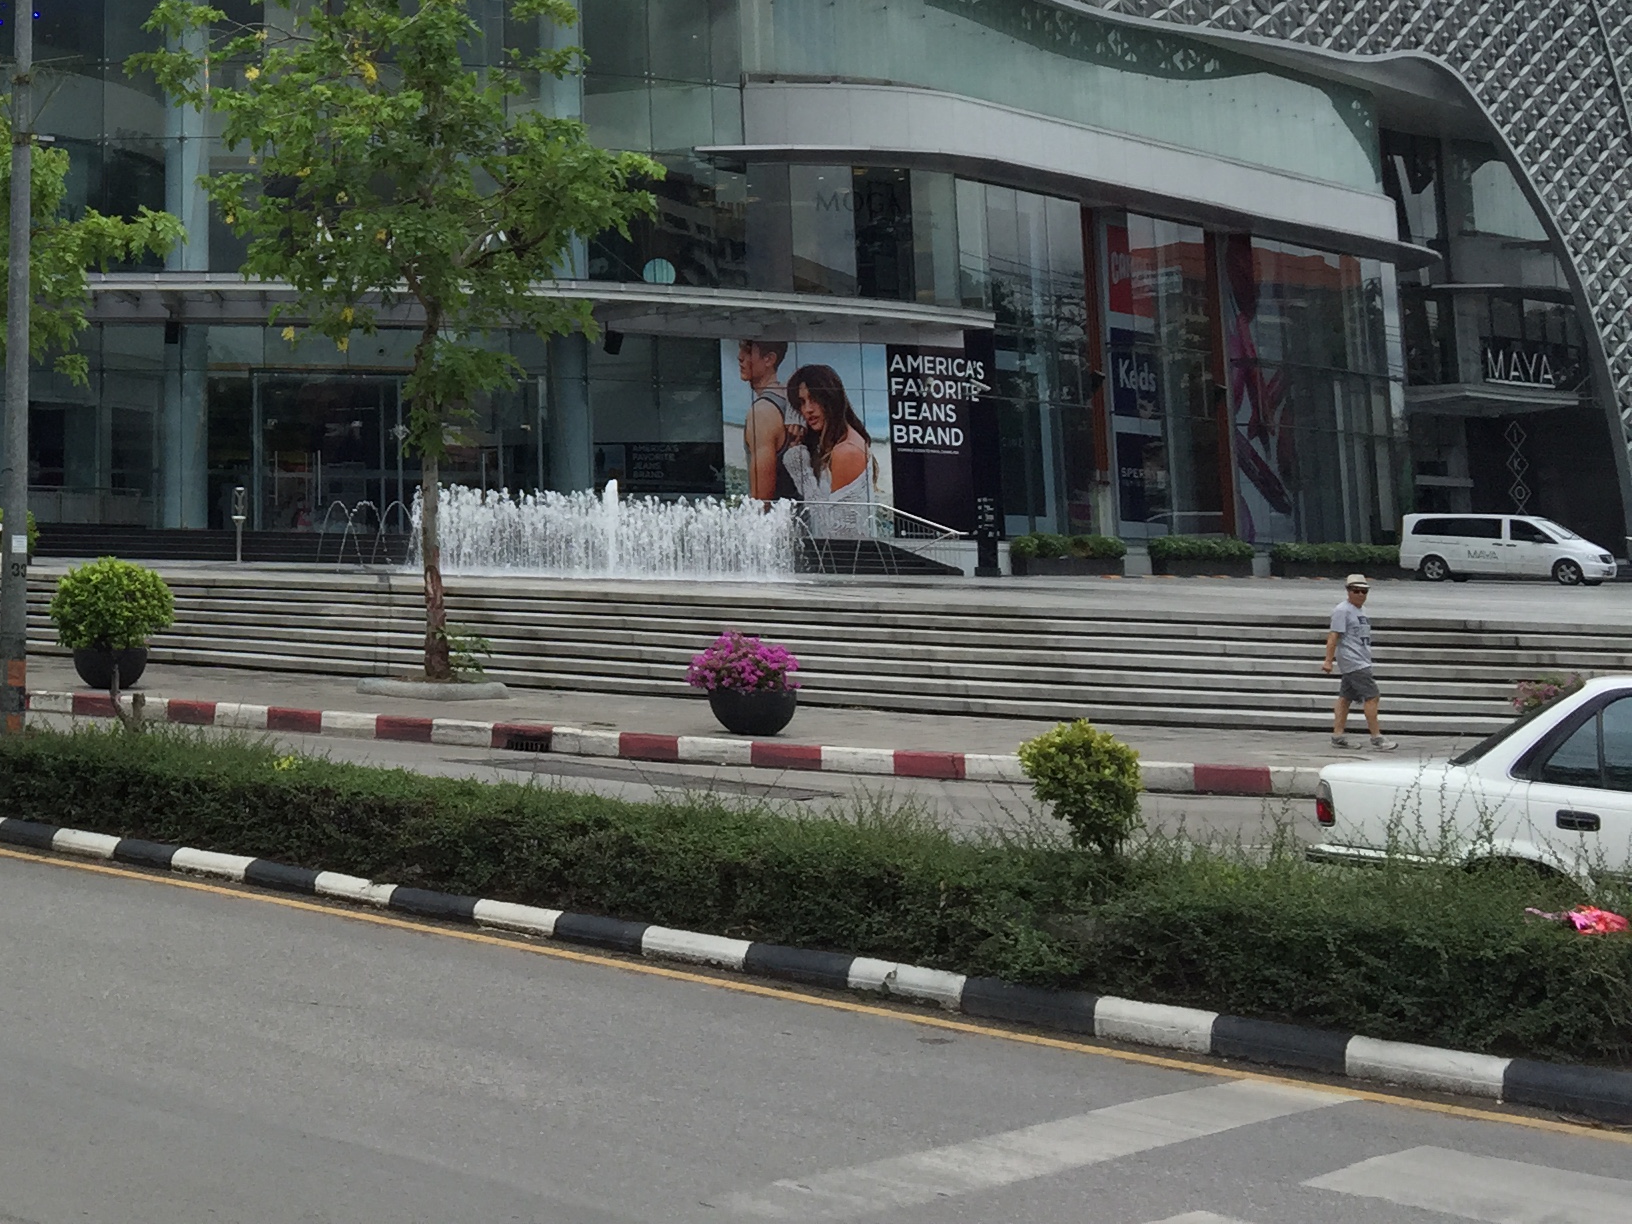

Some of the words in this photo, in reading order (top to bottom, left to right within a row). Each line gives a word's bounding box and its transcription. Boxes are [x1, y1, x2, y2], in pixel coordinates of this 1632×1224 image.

[889, 354, 985, 380] AMERICA'S
[1118, 357, 1156, 392] Keds
[1486, 347, 1555, 386] MAYA
[891, 377, 981, 403] FAVORITE
[891, 400, 958, 423] JEANS
[893, 424, 965, 447] BRAND
[1467, 549, 1499, 560] MAYA
